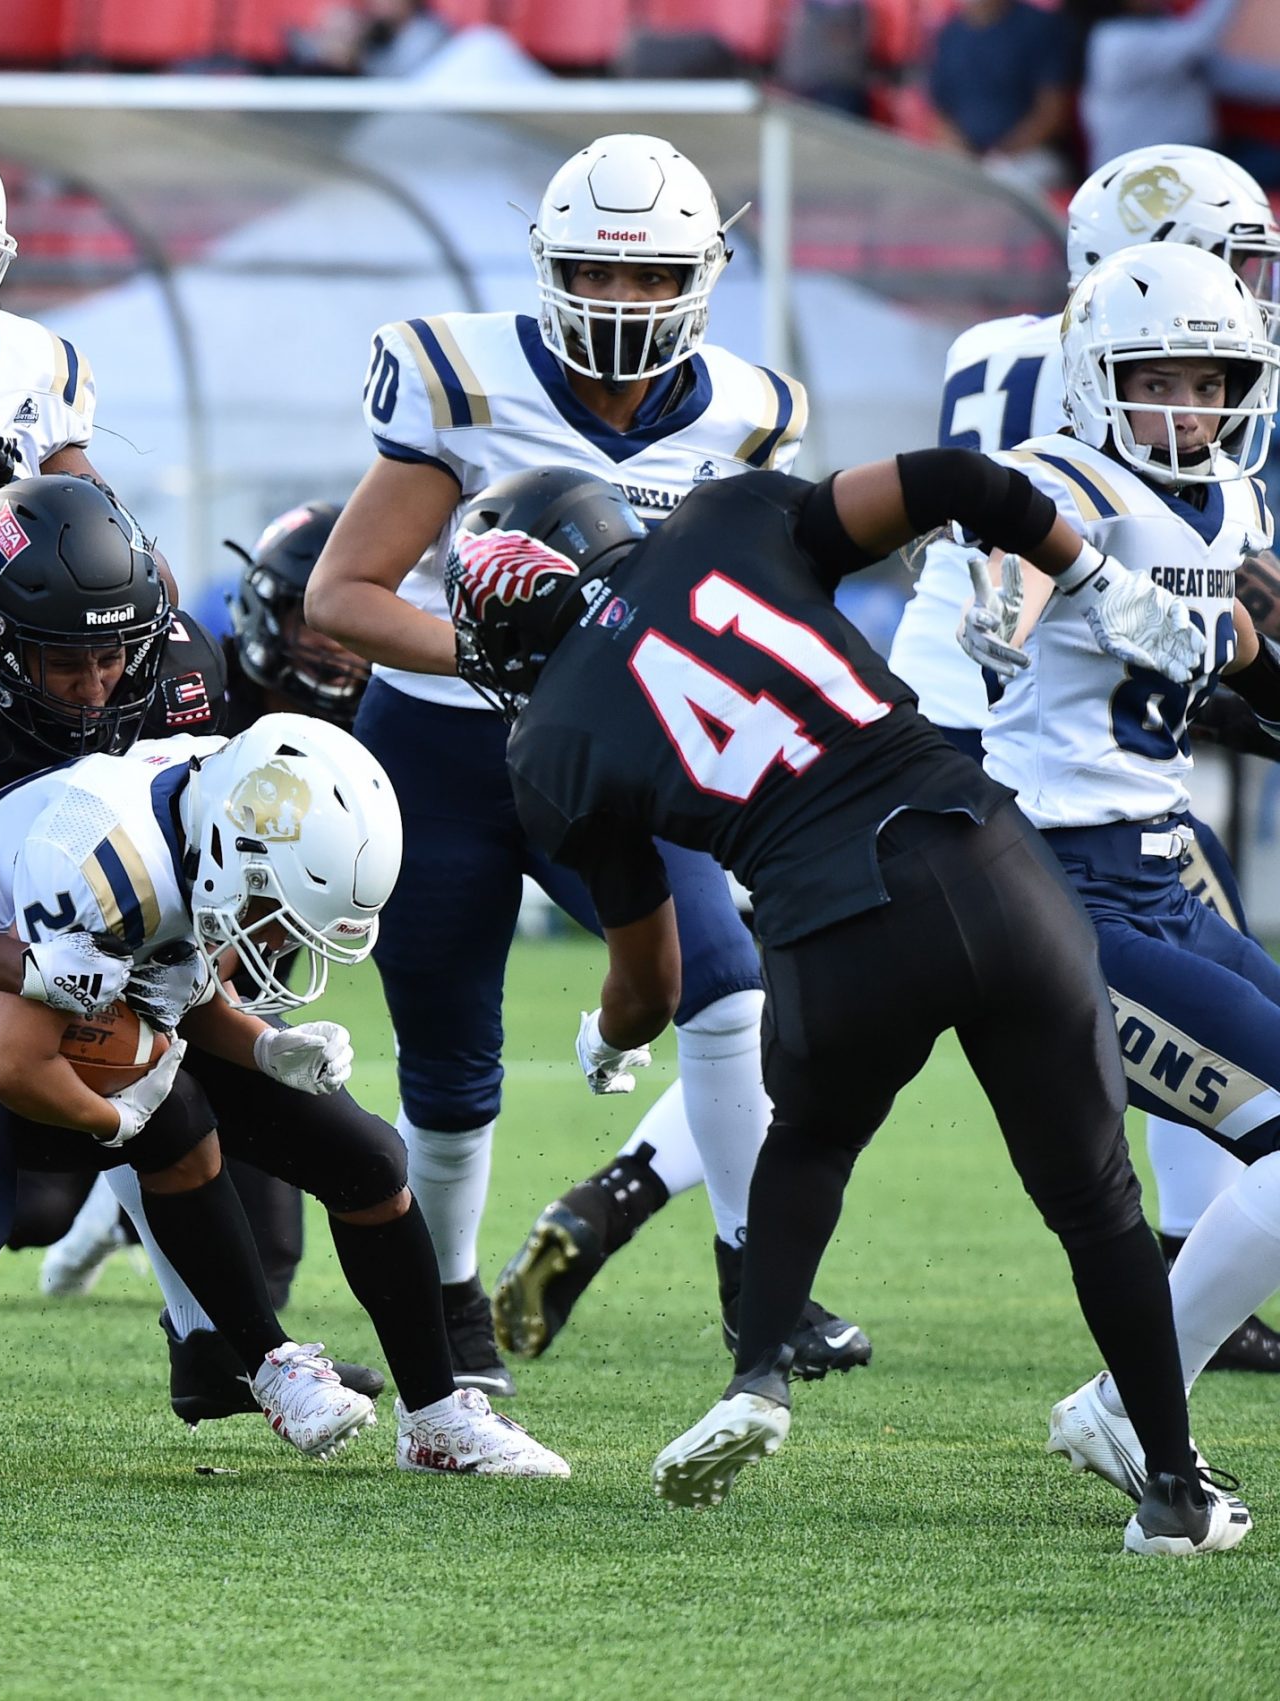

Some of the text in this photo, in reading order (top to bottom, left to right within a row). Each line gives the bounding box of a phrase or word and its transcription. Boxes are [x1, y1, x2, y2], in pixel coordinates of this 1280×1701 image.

[597, 229, 647, 242] Riddell
[1151, 566, 1204, 598] GREAT
[86, 606, 135, 625] Riddell
[579, 586, 612, 628] Riddell
[627, 568, 894, 805] 41
[23, 890, 86, 943] 2
[53, 976, 97, 1013] adidas
[1112, 1003, 1229, 1115] ONS
